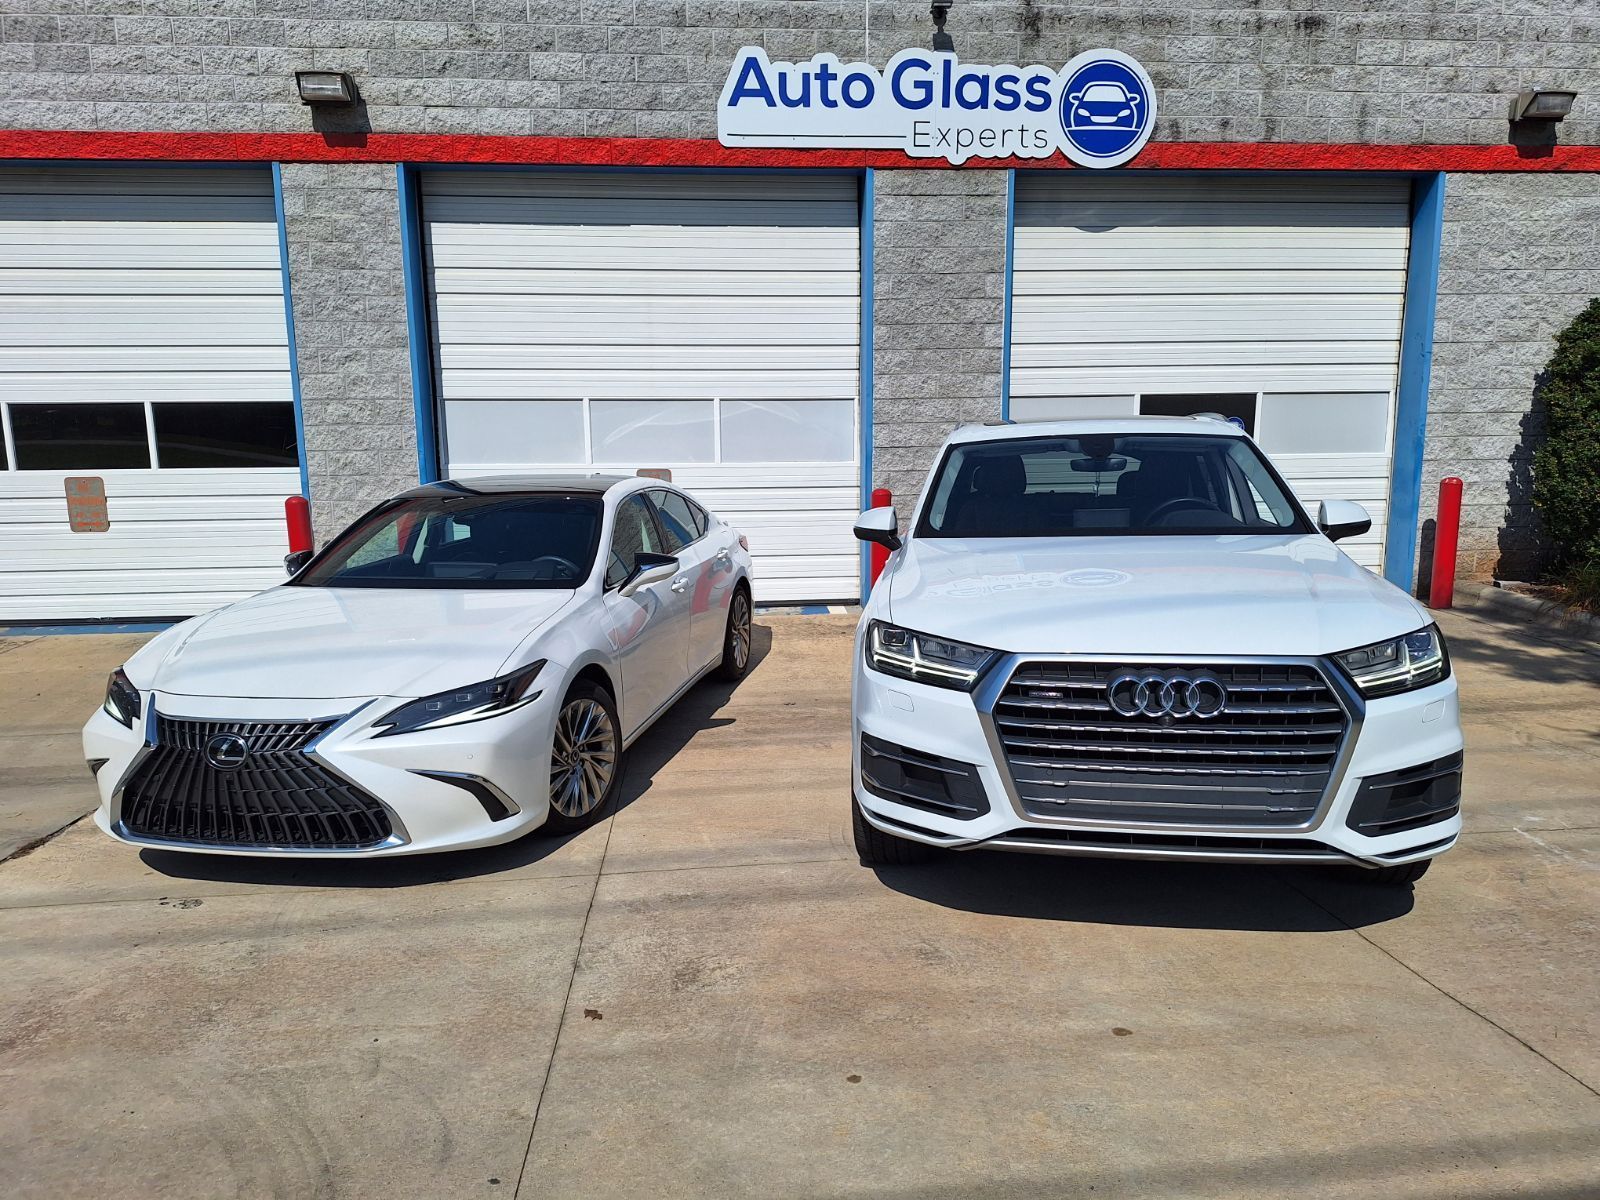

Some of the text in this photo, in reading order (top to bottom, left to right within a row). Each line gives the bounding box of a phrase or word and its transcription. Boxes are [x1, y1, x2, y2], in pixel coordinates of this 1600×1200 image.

[728, 56, 1052, 112] Auto Glass
[912, 120, 1049, 154] Experts
